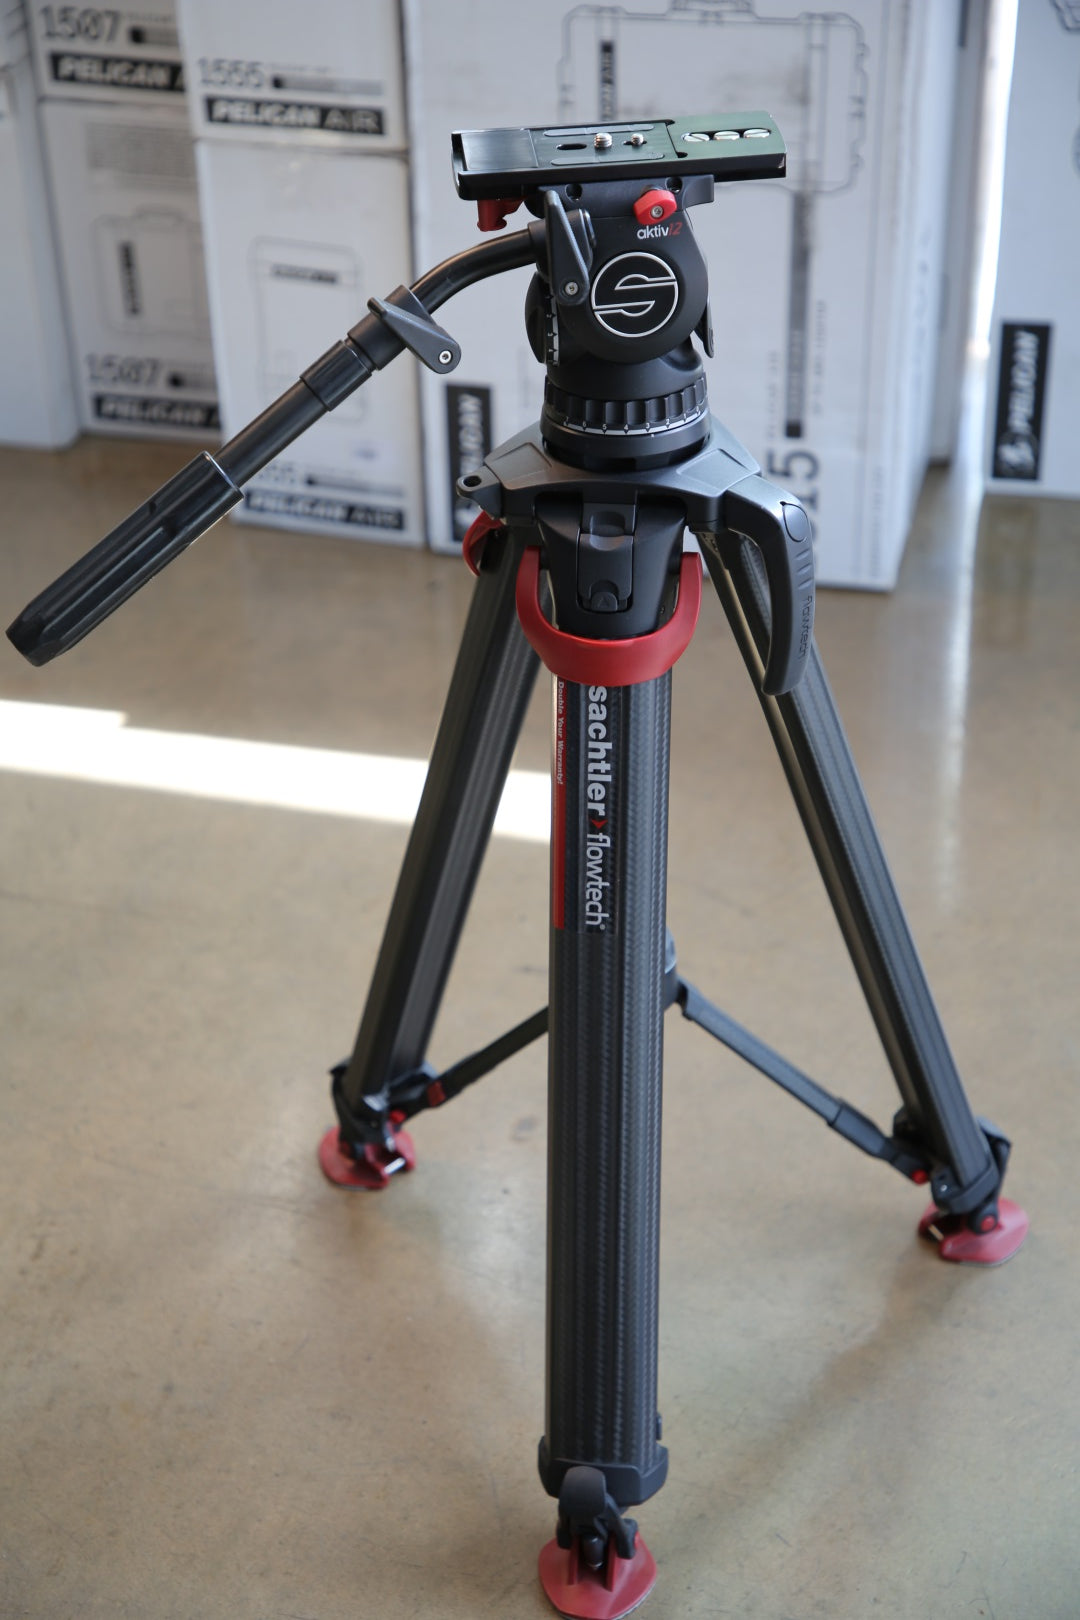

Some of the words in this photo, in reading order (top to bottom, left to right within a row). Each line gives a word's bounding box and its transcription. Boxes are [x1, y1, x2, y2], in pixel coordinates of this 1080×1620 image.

[212, 99, 322, 129] PELICAN
[557, 681, 565, 714] Double
[557, 717, 565, 738] Your
[586, 685, 613, 817] sachtler
